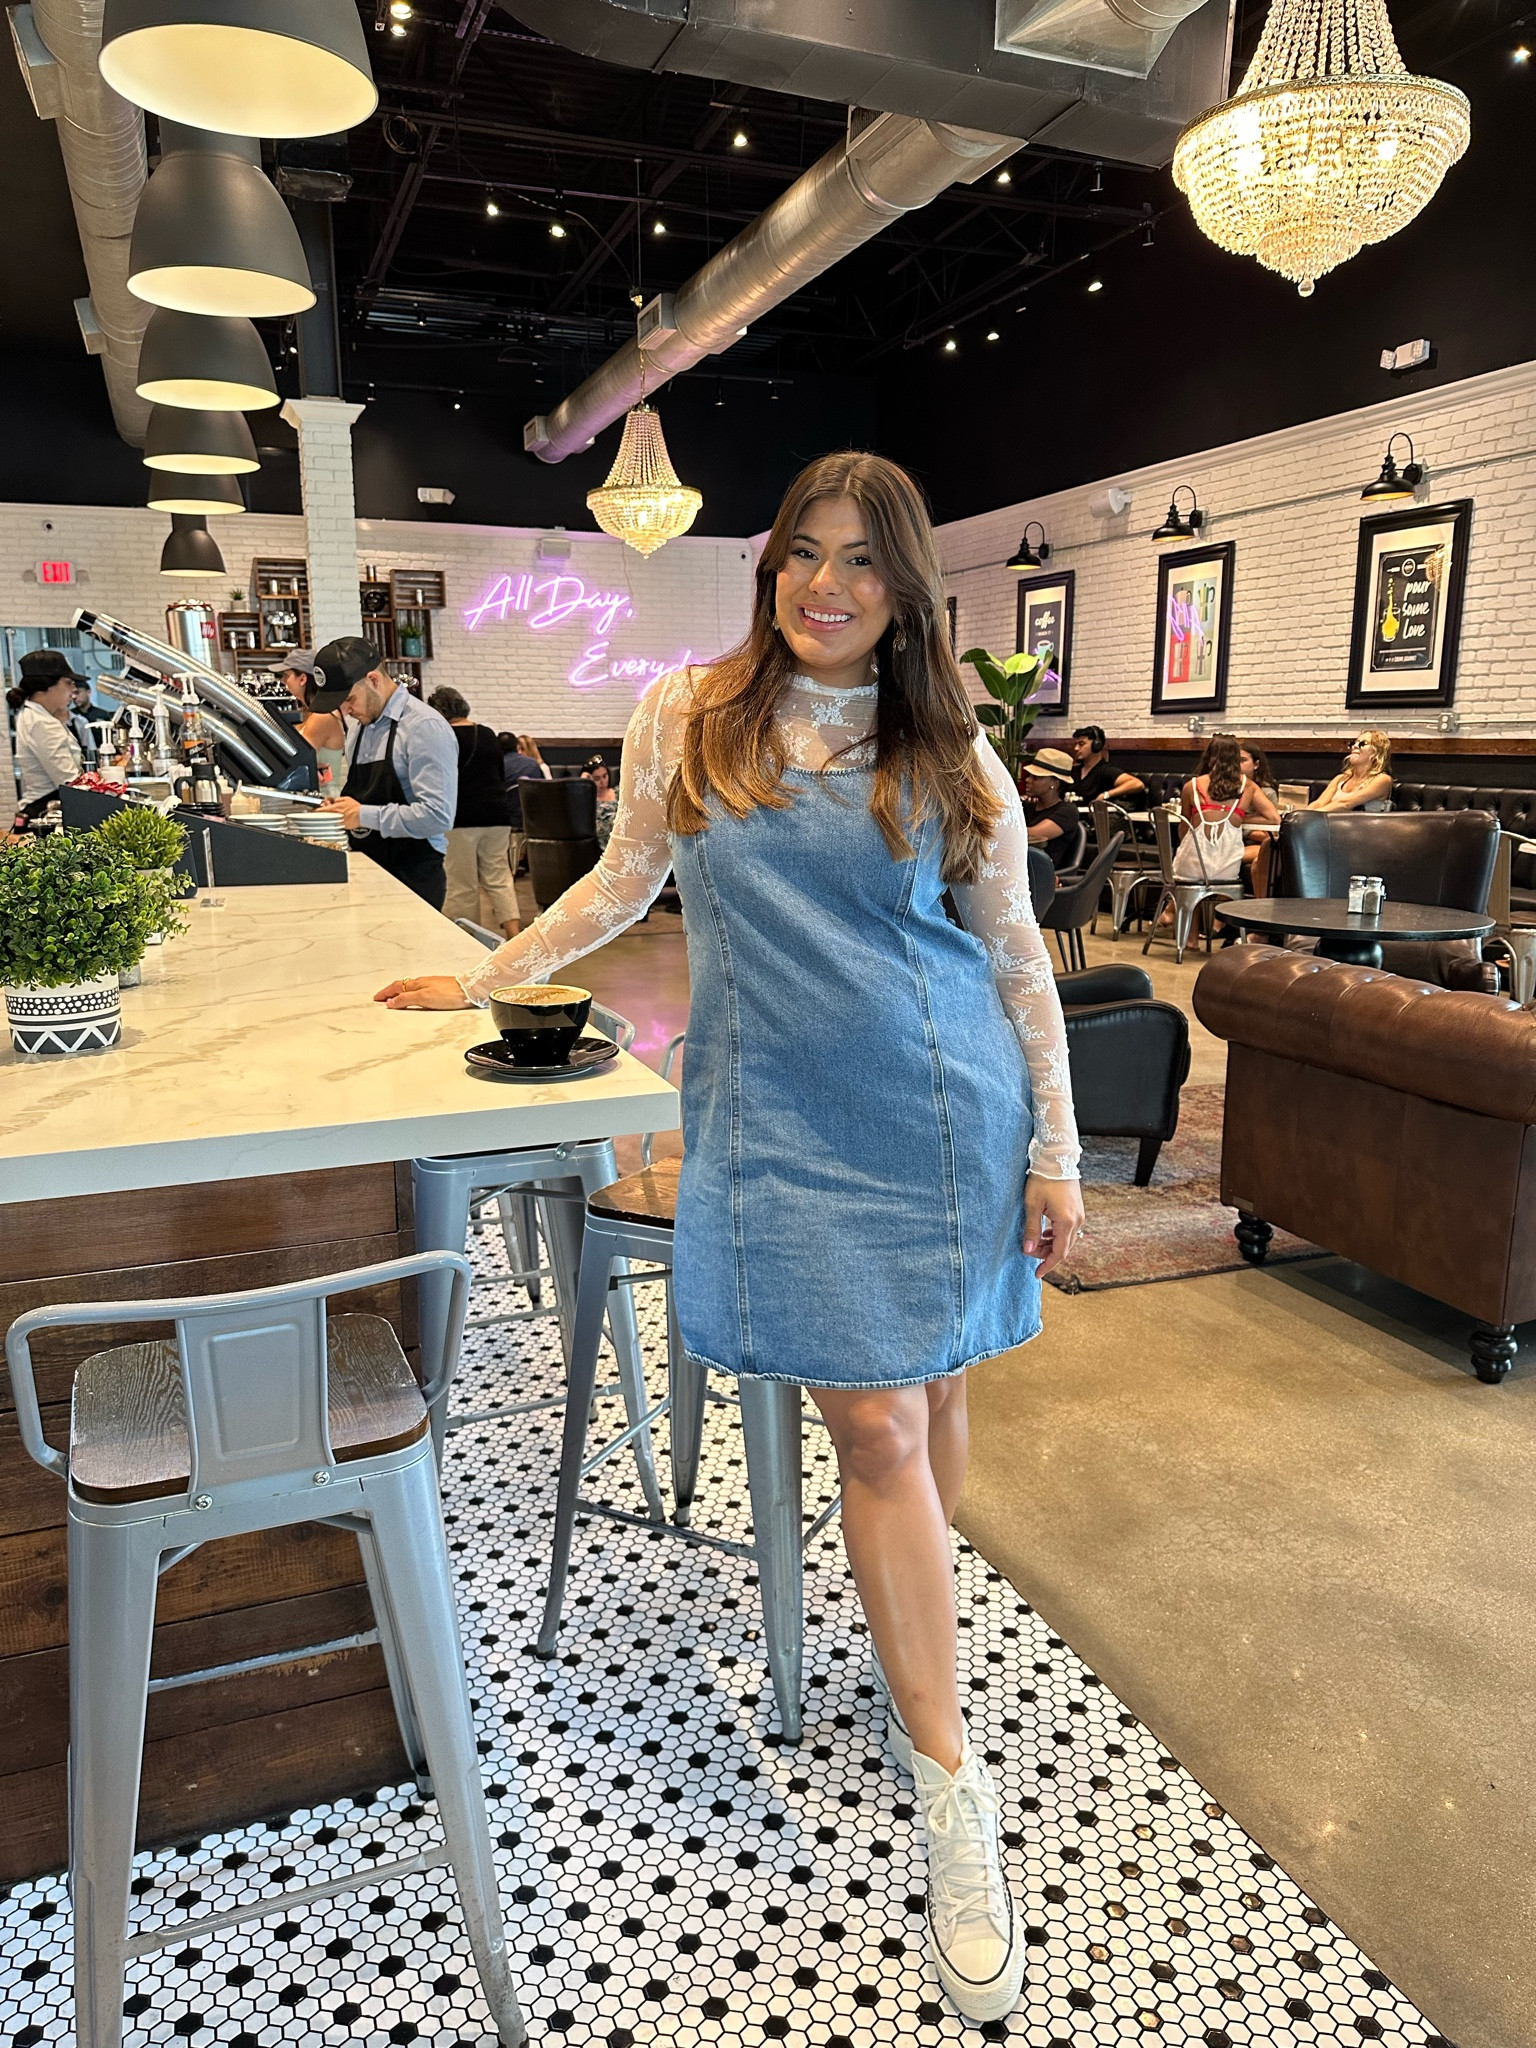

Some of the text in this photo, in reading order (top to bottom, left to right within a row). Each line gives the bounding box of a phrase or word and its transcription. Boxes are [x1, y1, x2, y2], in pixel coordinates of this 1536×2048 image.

[42, 561, 71, 584] EXIT
[1403, 581, 1432, 602] pour
[464, 574, 634, 635] All Day,
[1402, 602, 1430, 617] some
[1034, 610, 1056, 630] coffee
